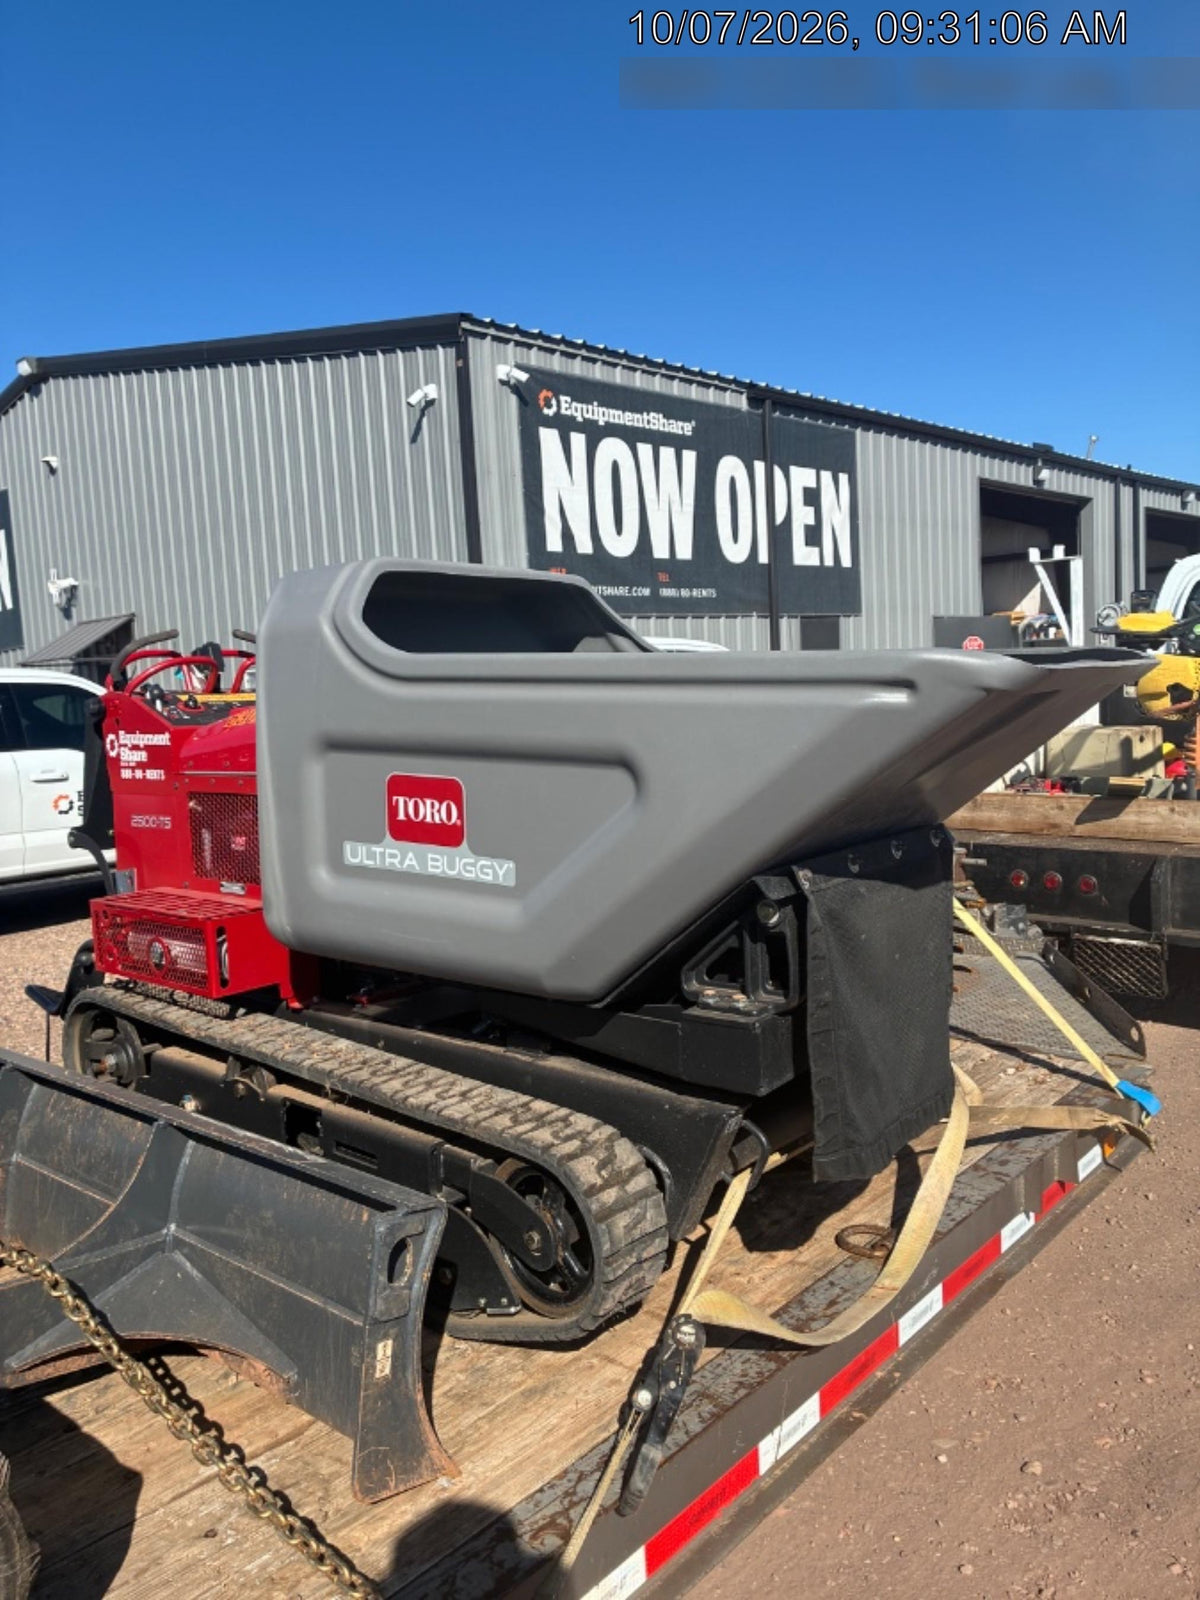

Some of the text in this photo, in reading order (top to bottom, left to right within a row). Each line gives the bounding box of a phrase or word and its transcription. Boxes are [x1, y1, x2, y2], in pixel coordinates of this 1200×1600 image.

[538, 427, 852, 568] NOW OPEN
[392, 796, 459, 826] TORO
[345, 844, 512, 881] ULTRA BUGGY
